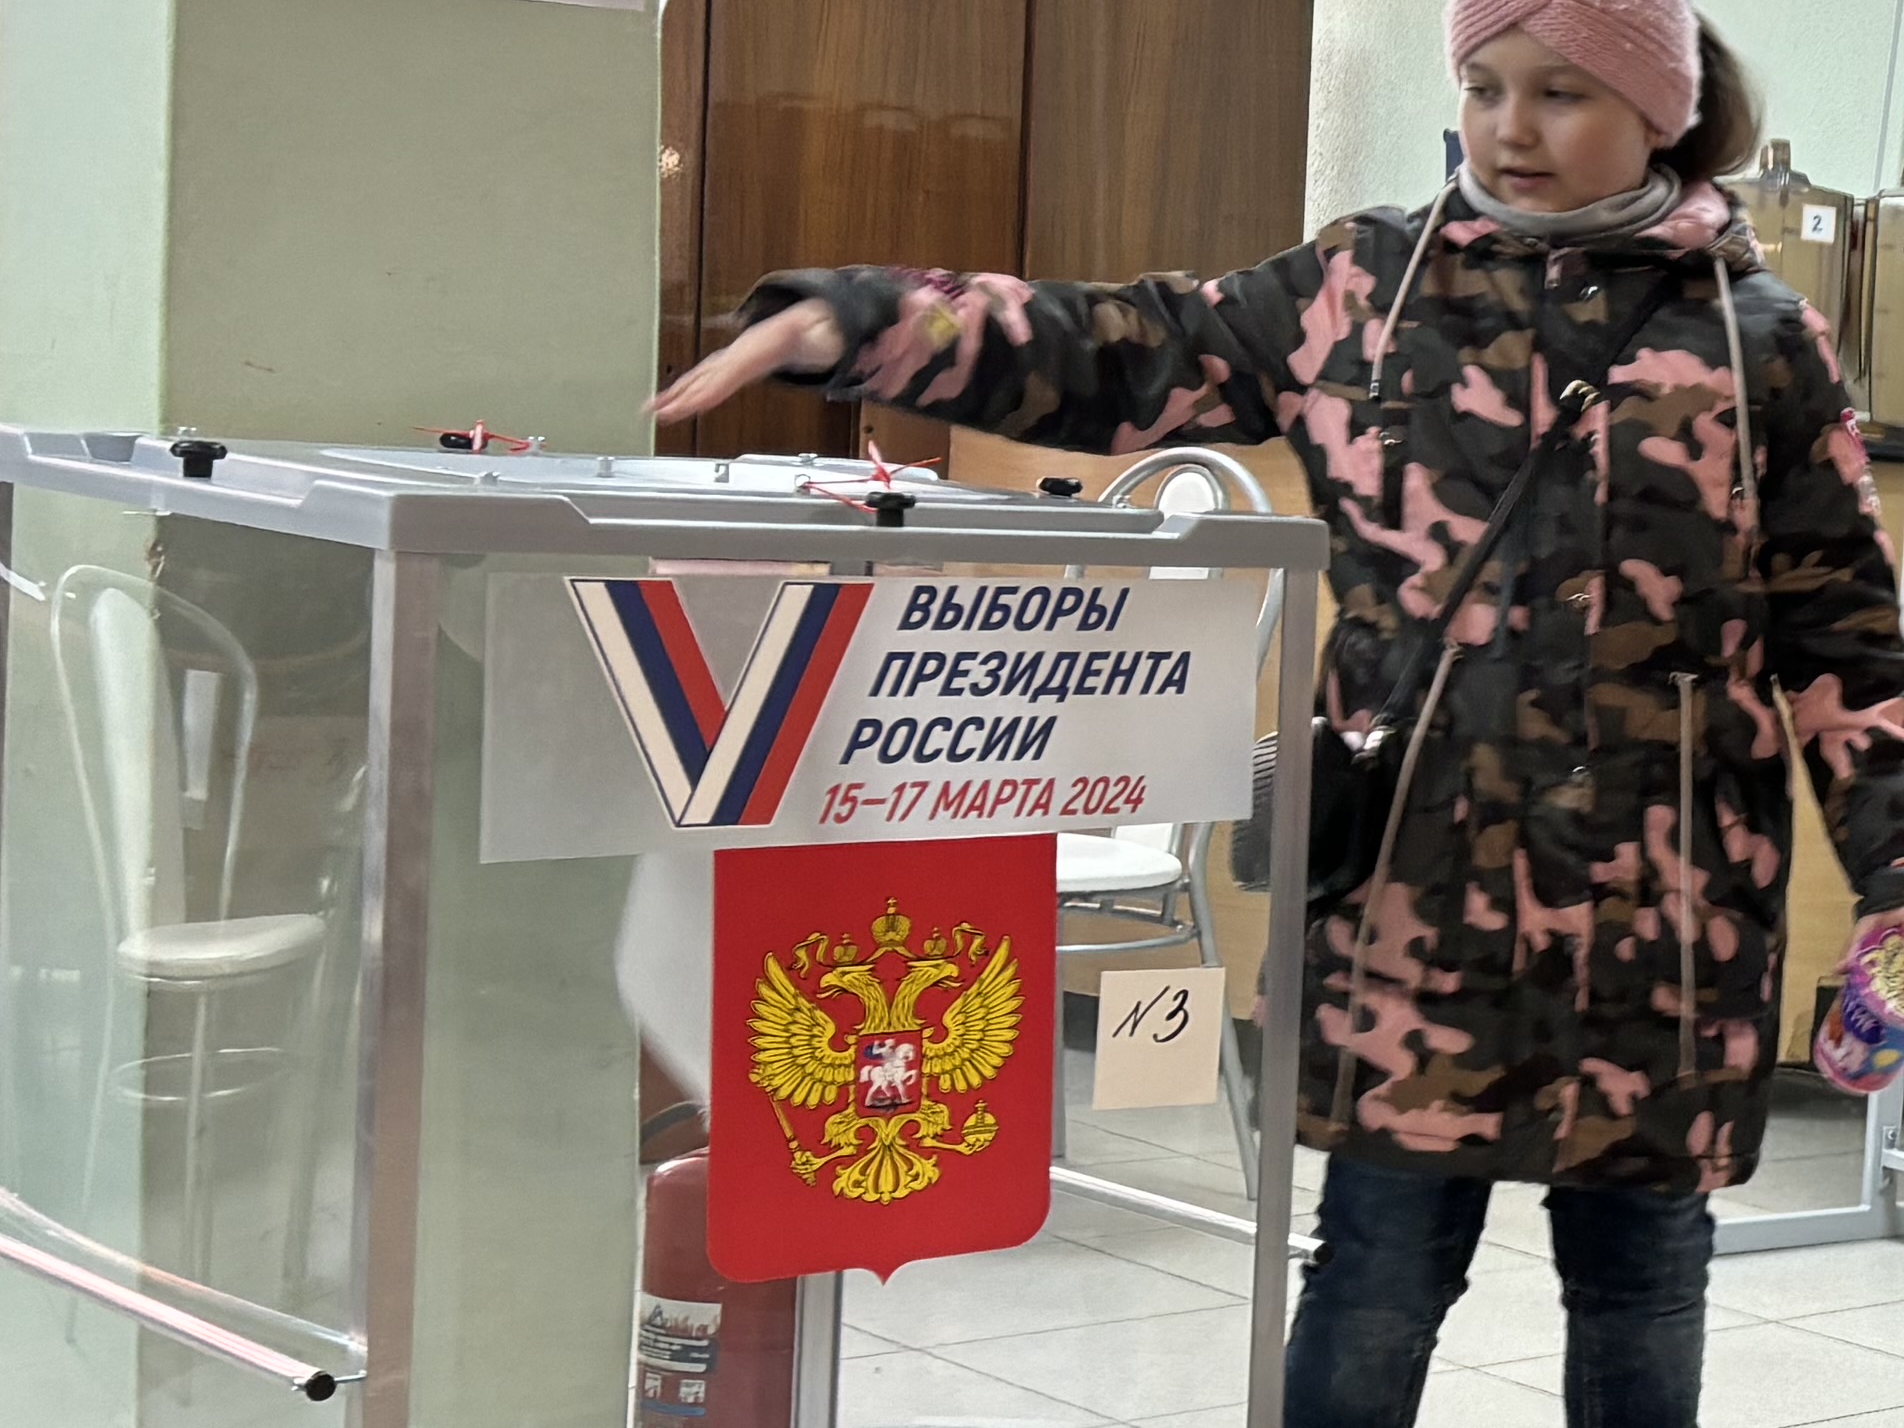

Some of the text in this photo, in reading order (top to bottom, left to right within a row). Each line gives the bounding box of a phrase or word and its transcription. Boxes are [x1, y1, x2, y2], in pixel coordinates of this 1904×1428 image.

[1812, 214, 1823, 233] 2
[897, 585, 1130, 631] ВЫБОРЫ
[868, 650, 1192, 703] ПРЕЗИДЕНТА
[839, 715, 1058, 765] РОССИИ
[930, 778, 1057, 821] МАРТА
[1060, 775, 1146, 816] 2024
